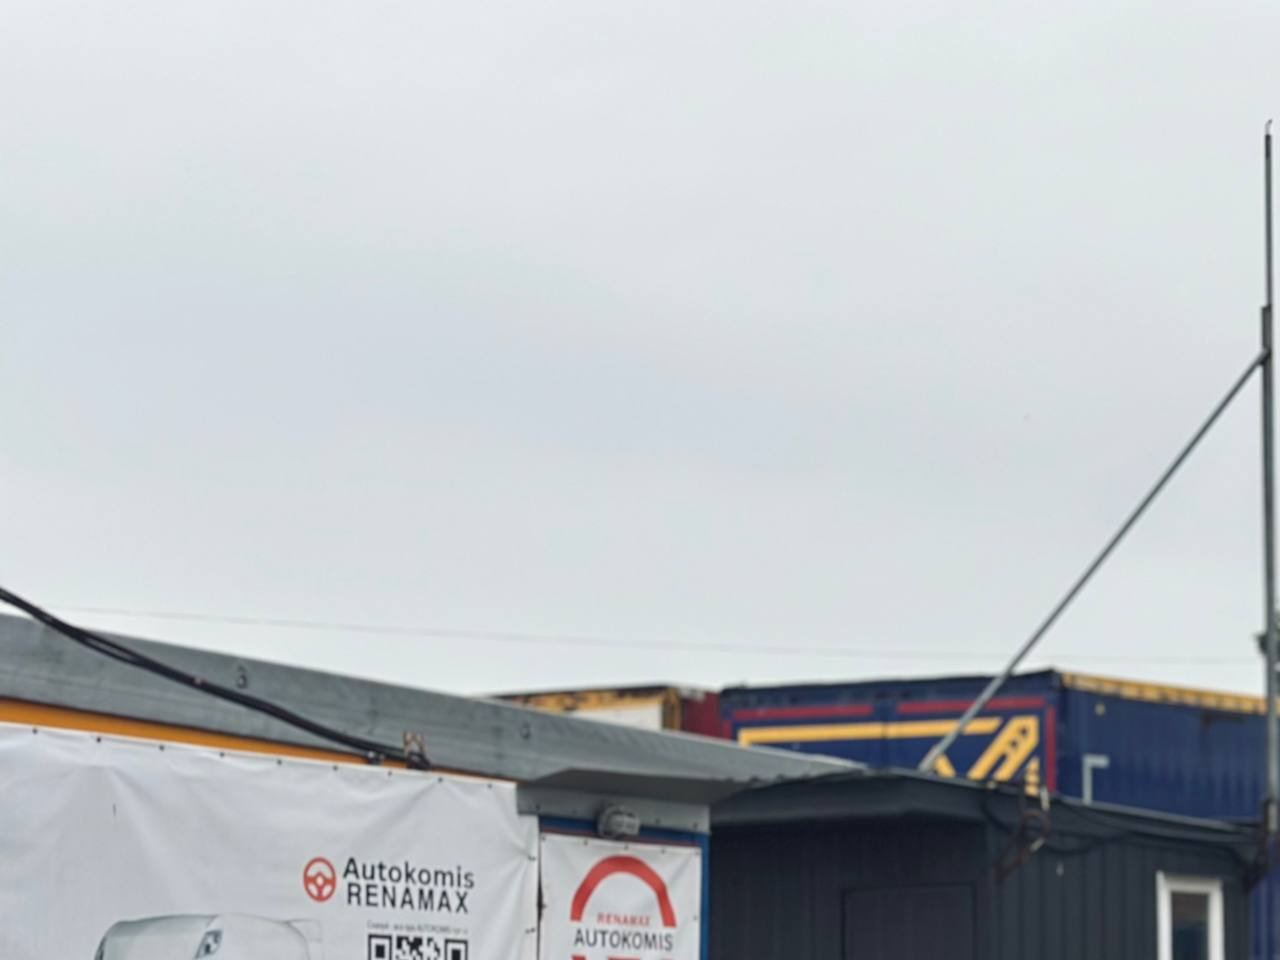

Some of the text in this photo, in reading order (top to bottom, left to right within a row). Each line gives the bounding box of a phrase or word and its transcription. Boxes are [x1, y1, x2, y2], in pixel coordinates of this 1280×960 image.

[343, 857, 474, 889] Autokomis
[347, 882, 468, 914] RENAMAX
[573, 927, 674, 951] AUTOKOMIS
